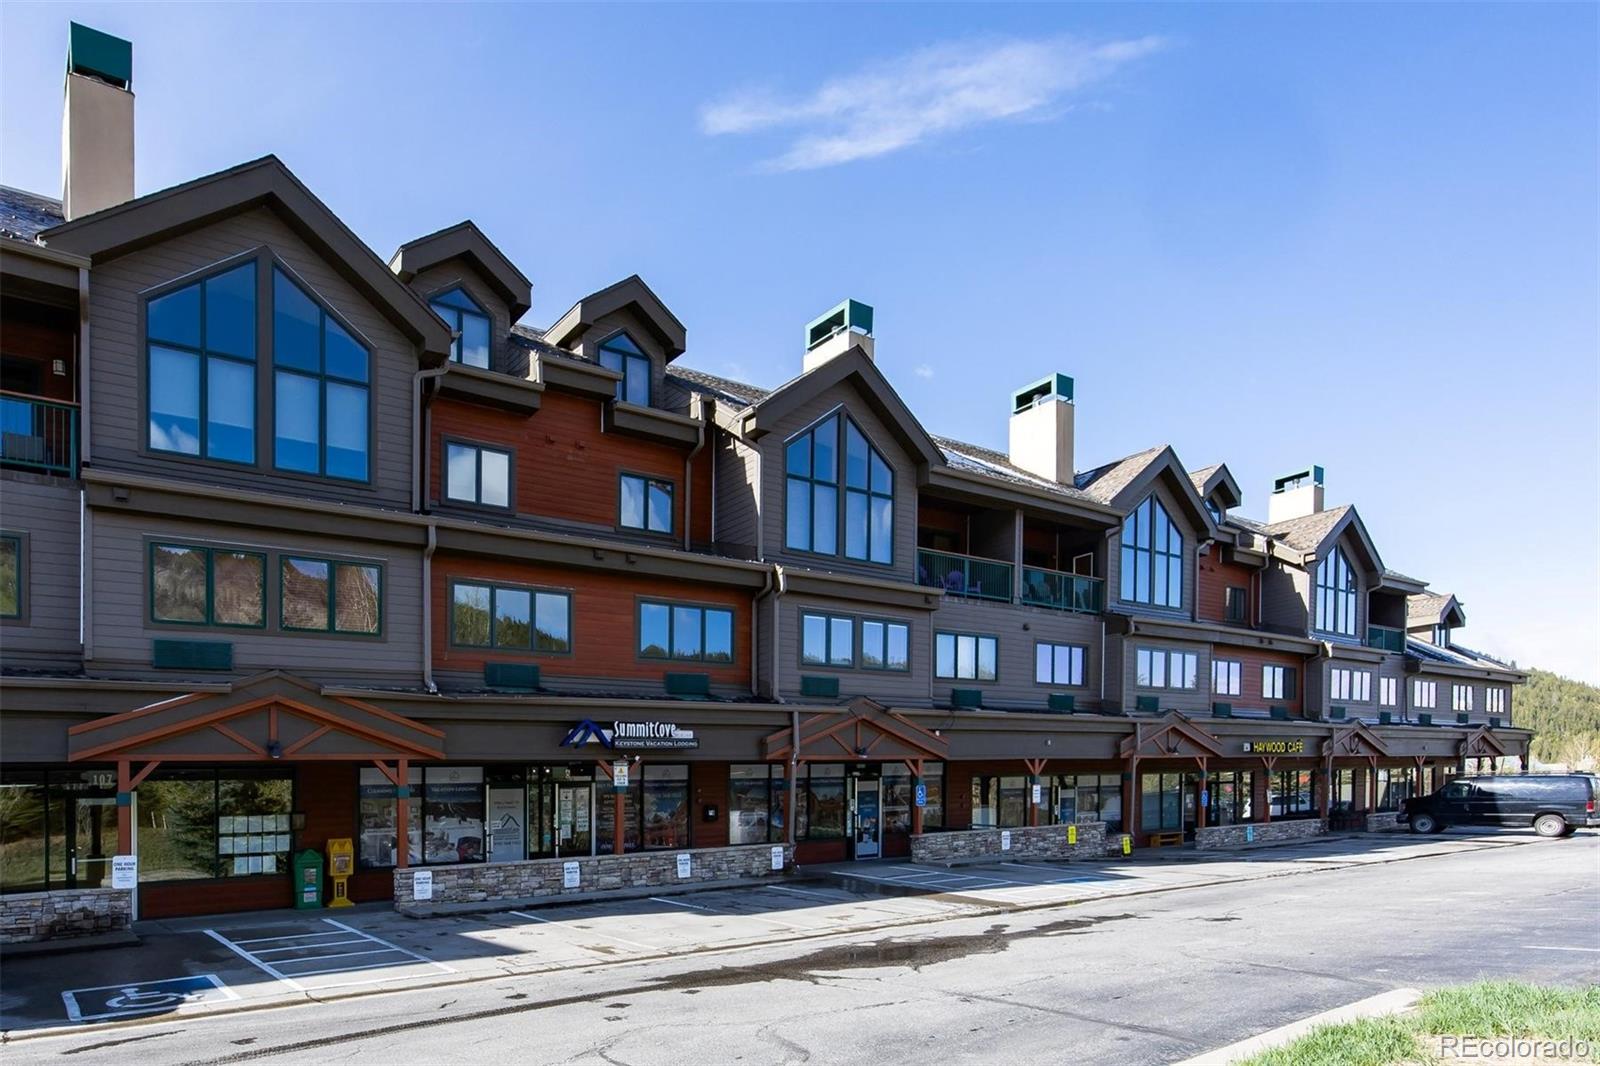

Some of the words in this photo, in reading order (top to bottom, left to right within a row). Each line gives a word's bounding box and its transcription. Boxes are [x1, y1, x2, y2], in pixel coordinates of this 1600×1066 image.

[614, 721, 676, 738] SummitCove
[646, 740, 673, 748] VACATION
[674, 740, 698, 748] LODGING
[1253, 742, 1286, 752] HAYWOOD
[93, 774, 113, 786] 107
